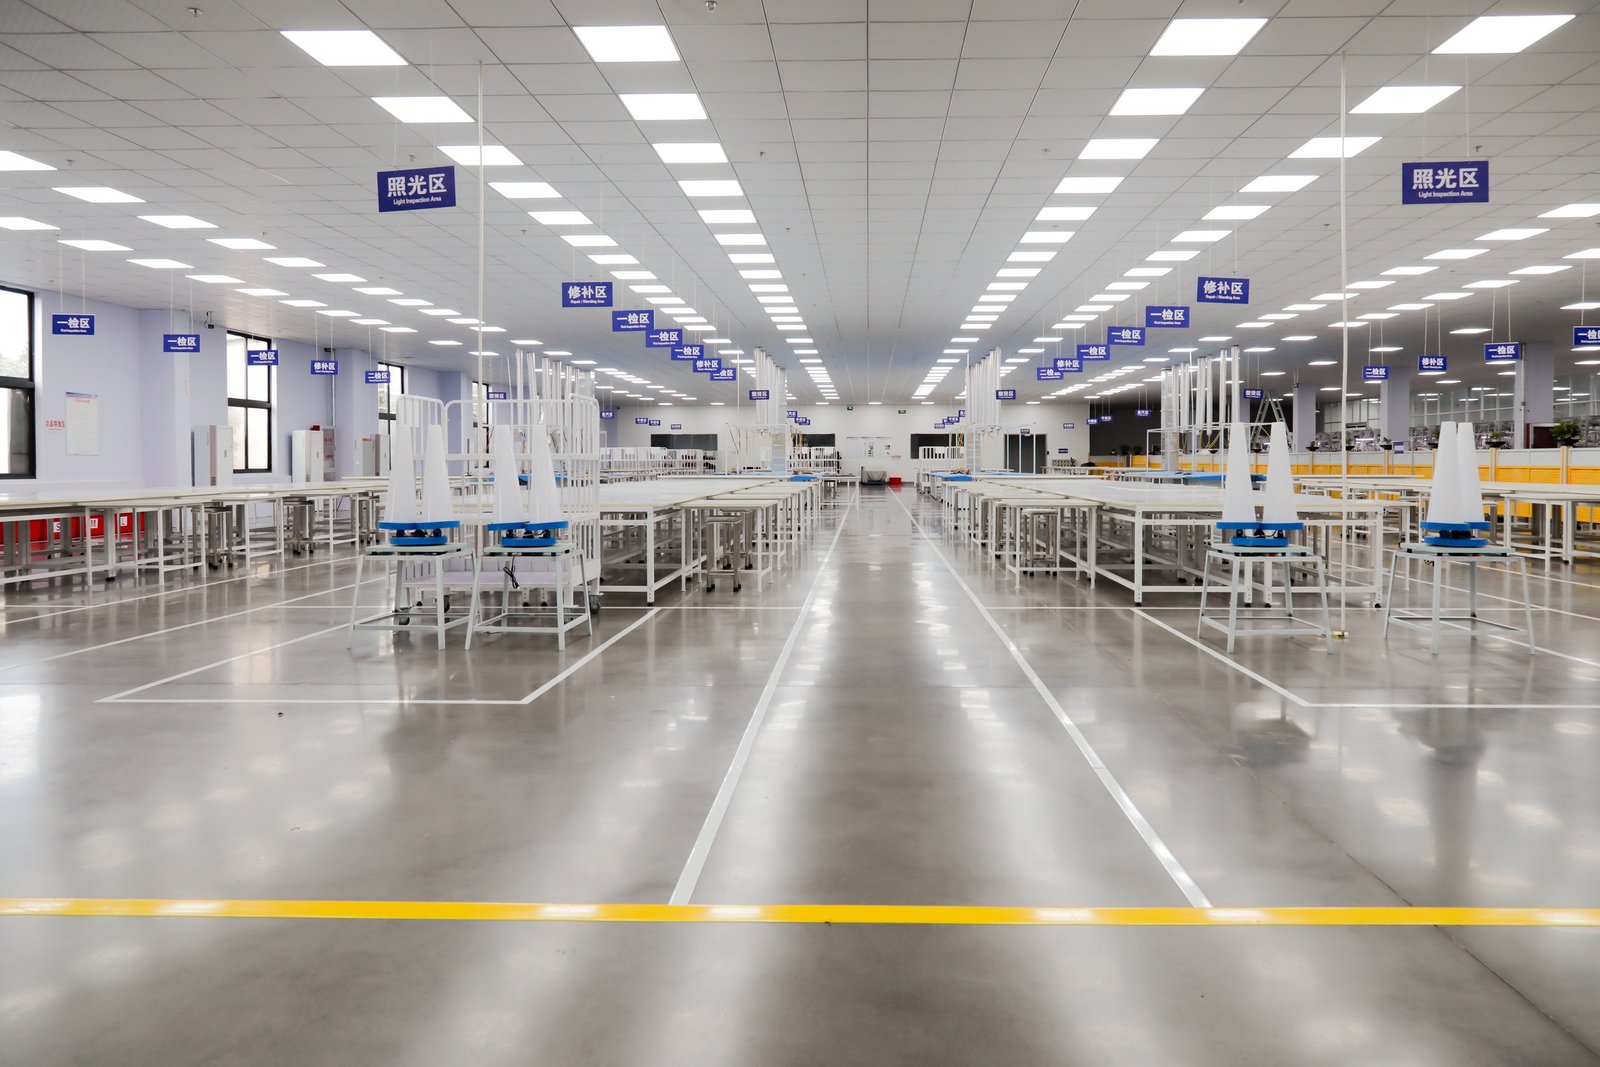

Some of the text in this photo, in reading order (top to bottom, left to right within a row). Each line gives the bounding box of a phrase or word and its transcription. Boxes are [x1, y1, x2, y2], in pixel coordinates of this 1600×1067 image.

[1412, 168, 1479, 190] 照光区
[388, 174, 447, 197] 照光区
[393, 198, 405, 206] Light
[568, 285, 607, 299] 修补区
[1203, 281, 1243, 294] 修补区
[617, 313, 650, 324] 一检区
[1150, 309, 1185, 320] 一检区
[57, 317, 90, 328] 一检区
[650, 332, 679, 341] 一检区
[1111, 329, 1141, 339] 一检区
[168, 337, 196, 346] 一检区
[675, 347, 700, 355] 一检区
[1080, 347, 1106, 355] 一检区
[1488, 346, 1515, 354] 一检区
[251, 352, 275, 360] 一检区
[314, 362, 335, 370] 修补区
[696, 360, 718, 368] 修补区
